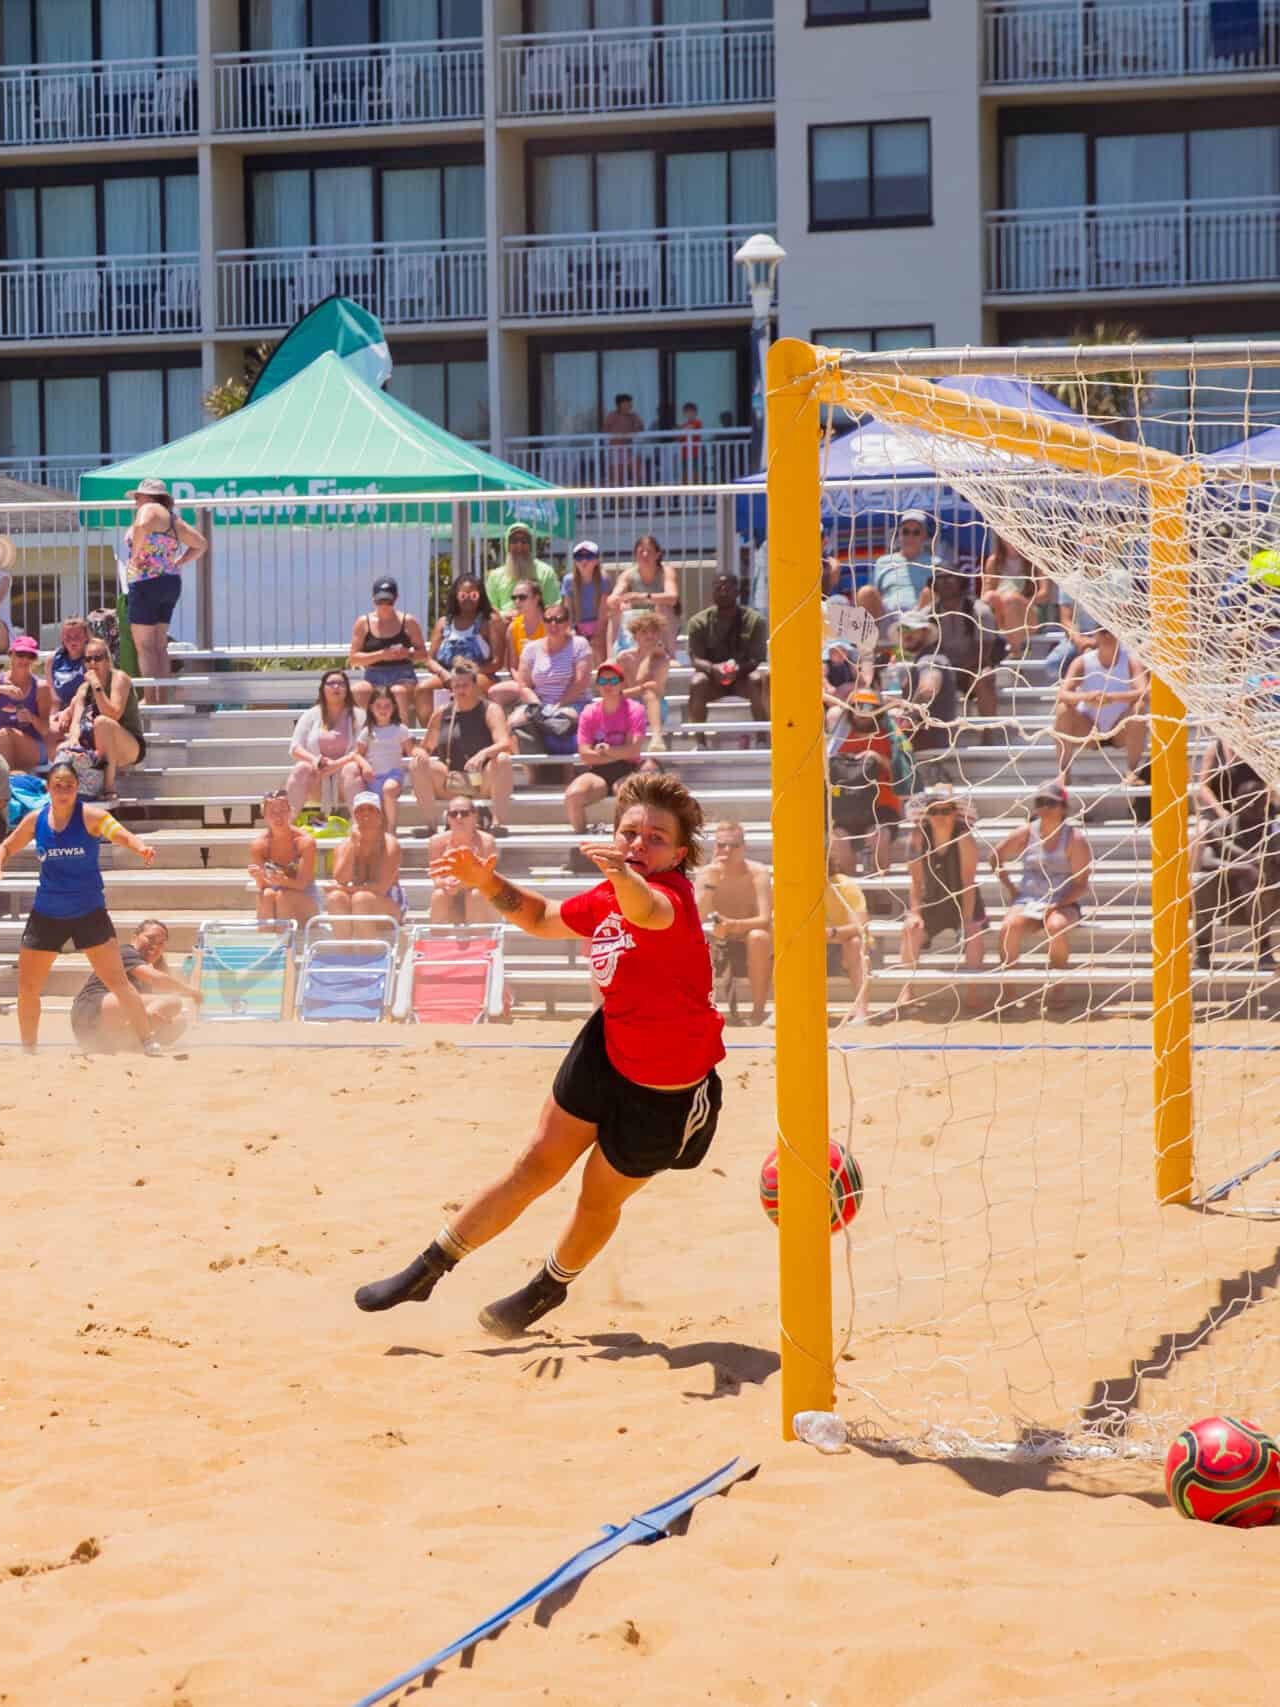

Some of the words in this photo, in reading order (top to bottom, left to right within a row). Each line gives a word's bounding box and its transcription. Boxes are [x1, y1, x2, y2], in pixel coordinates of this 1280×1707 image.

[171, 480, 297, 517] Patient
[308, 479, 379, 515] First
[48, 847, 85, 857] SEVWSA
